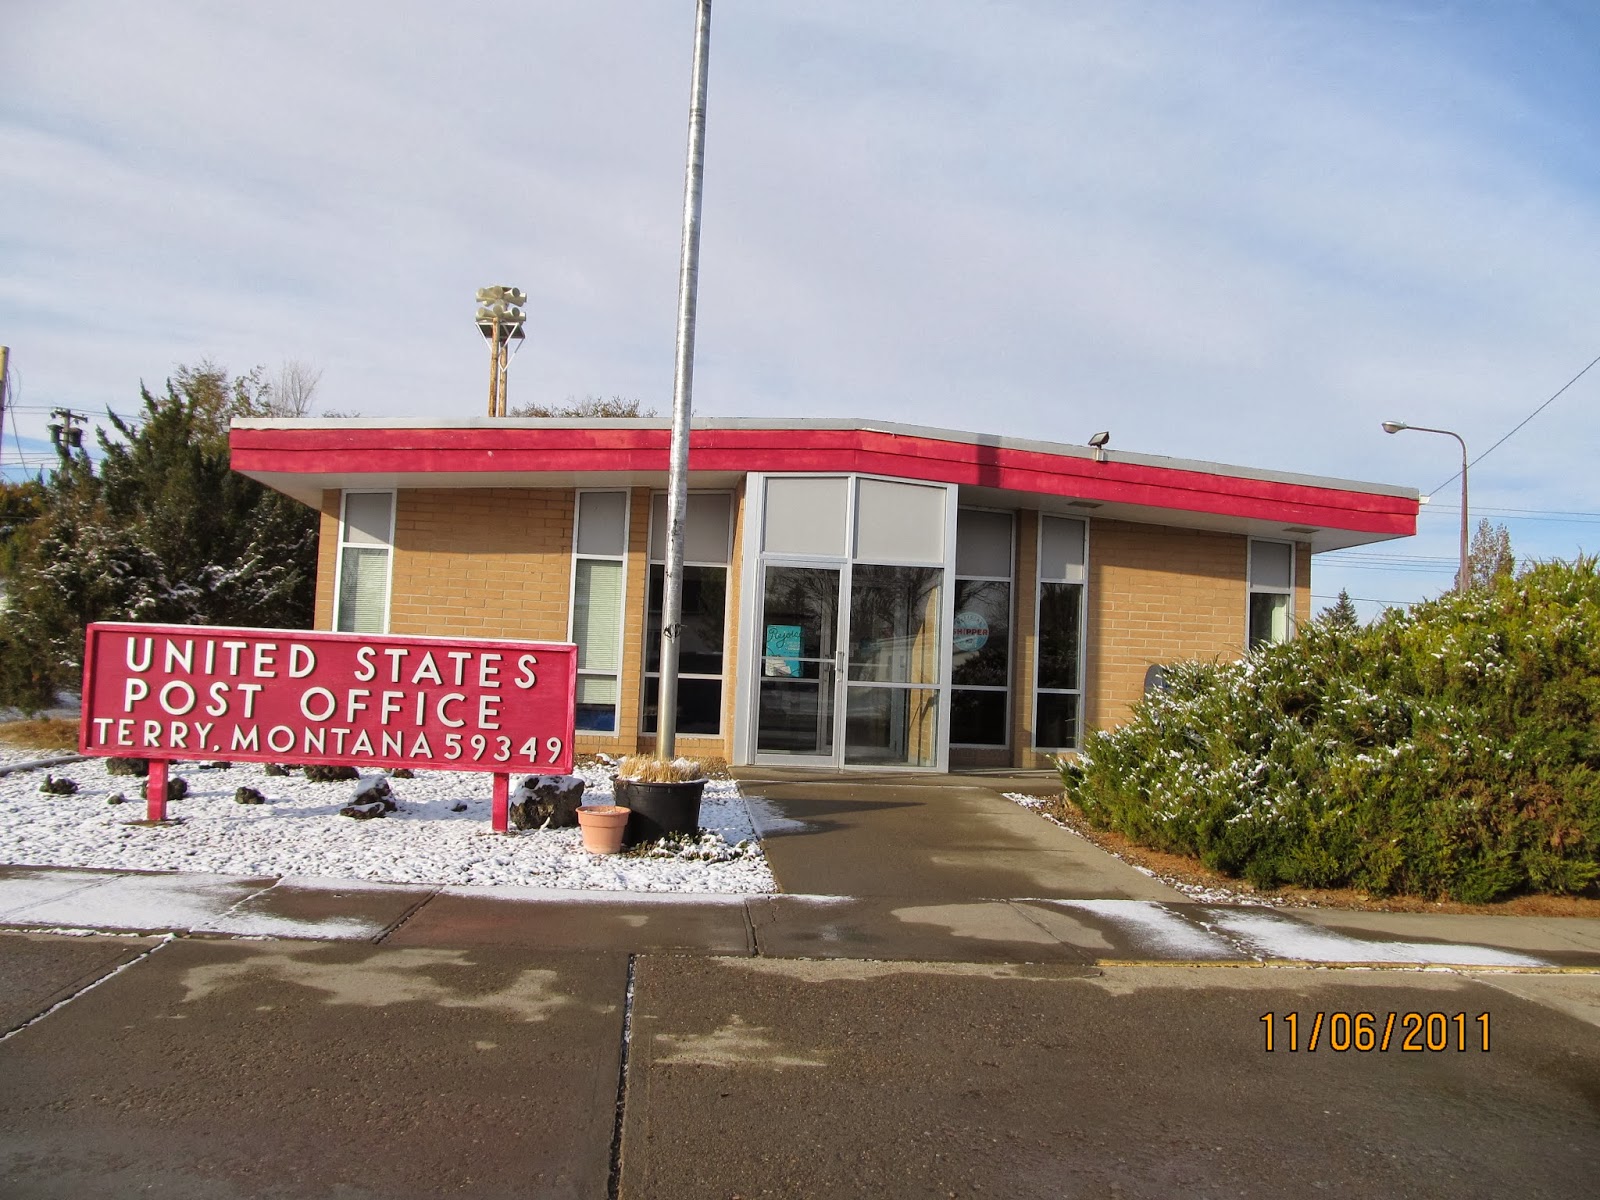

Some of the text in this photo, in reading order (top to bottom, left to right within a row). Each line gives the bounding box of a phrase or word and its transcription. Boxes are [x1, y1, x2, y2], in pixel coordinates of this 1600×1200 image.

[126, 637, 538, 689] UNITED STATES
[124, 678, 501, 730] POST OFFICE
[93, 717, 563, 764] TERRY, MONTANA 59349
